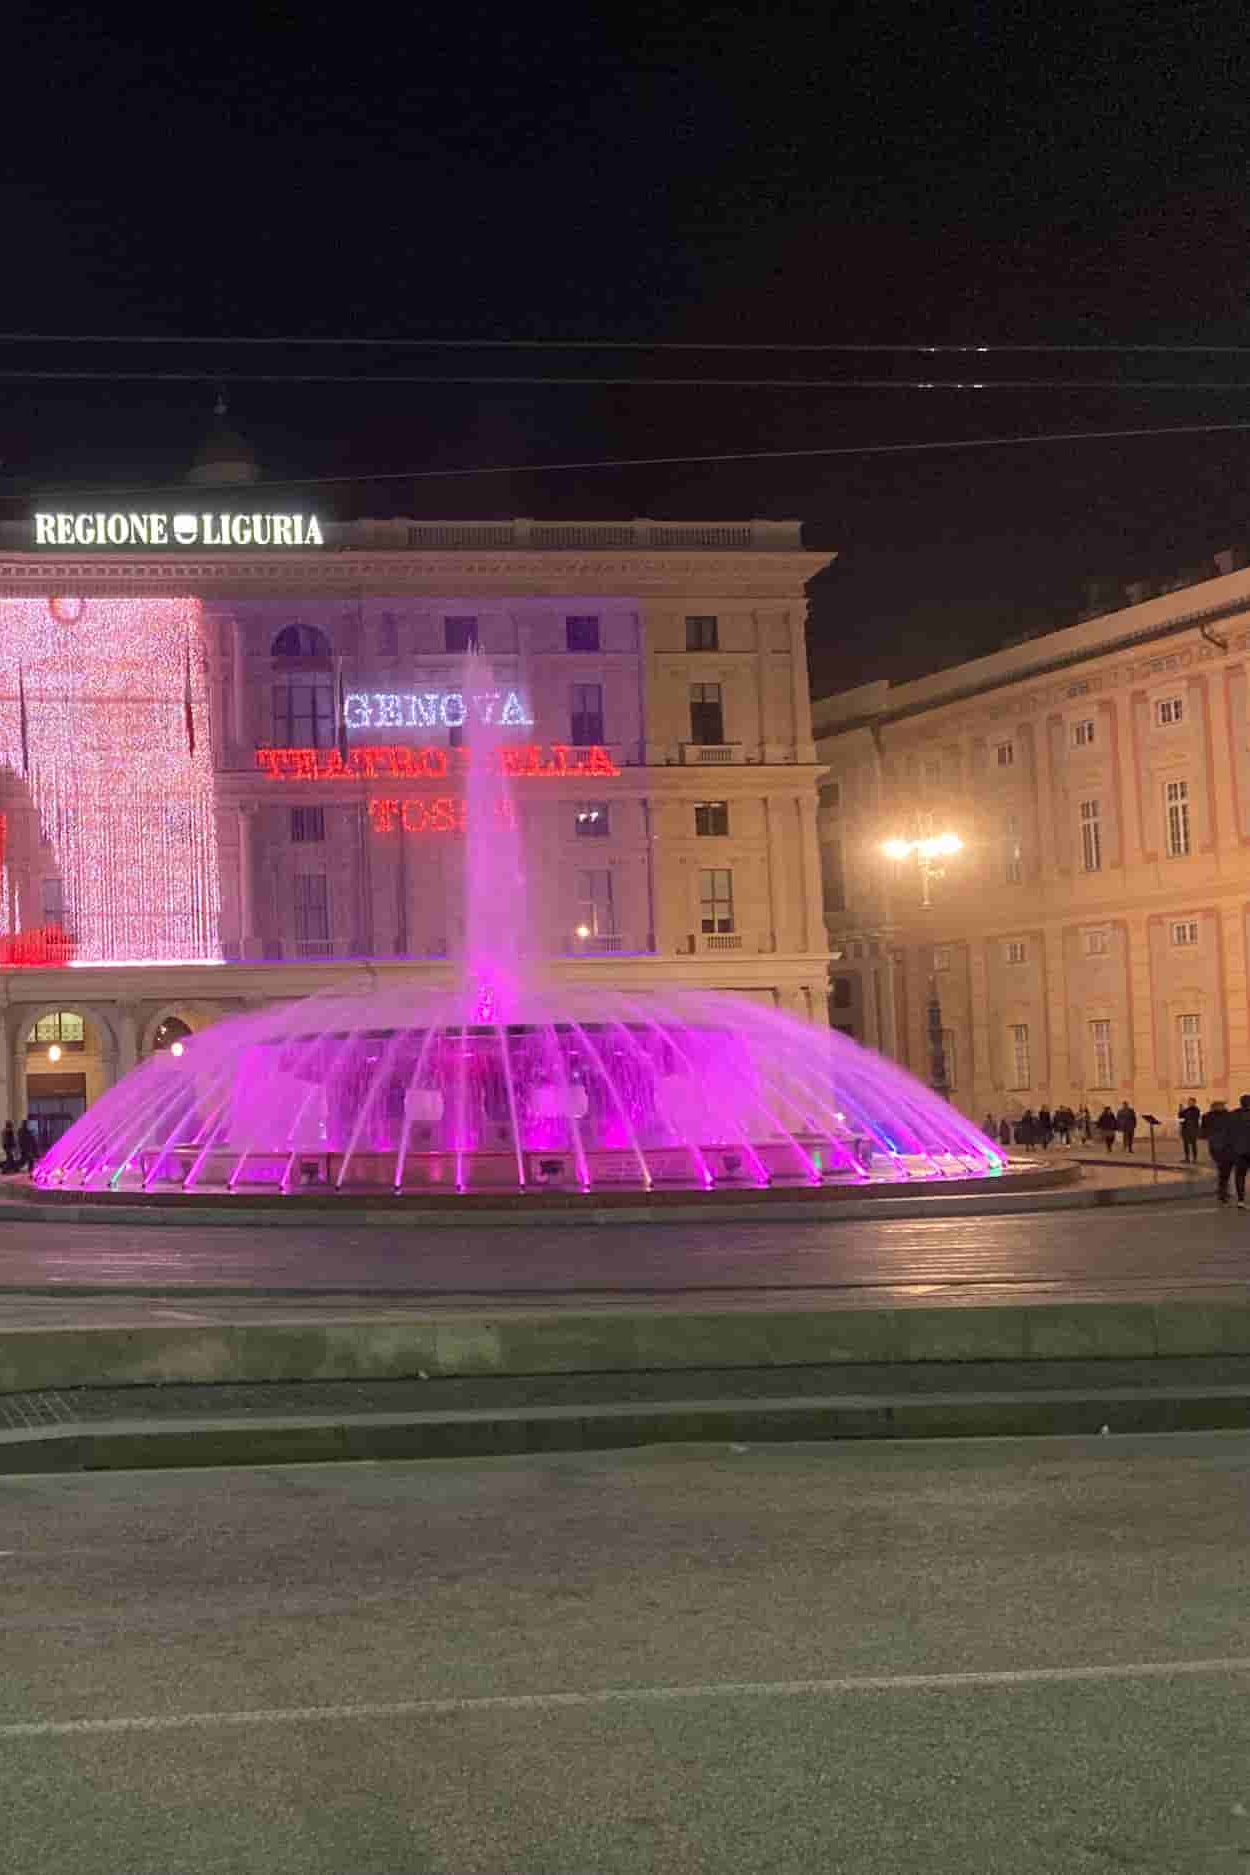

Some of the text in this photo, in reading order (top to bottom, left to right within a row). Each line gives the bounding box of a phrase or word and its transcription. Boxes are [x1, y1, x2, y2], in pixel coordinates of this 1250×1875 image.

[35, 513, 323, 544] REGIONE LIGURIA
[343, 692, 535, 728] GENOVA
[454, 746, 623, 777] ELLA
